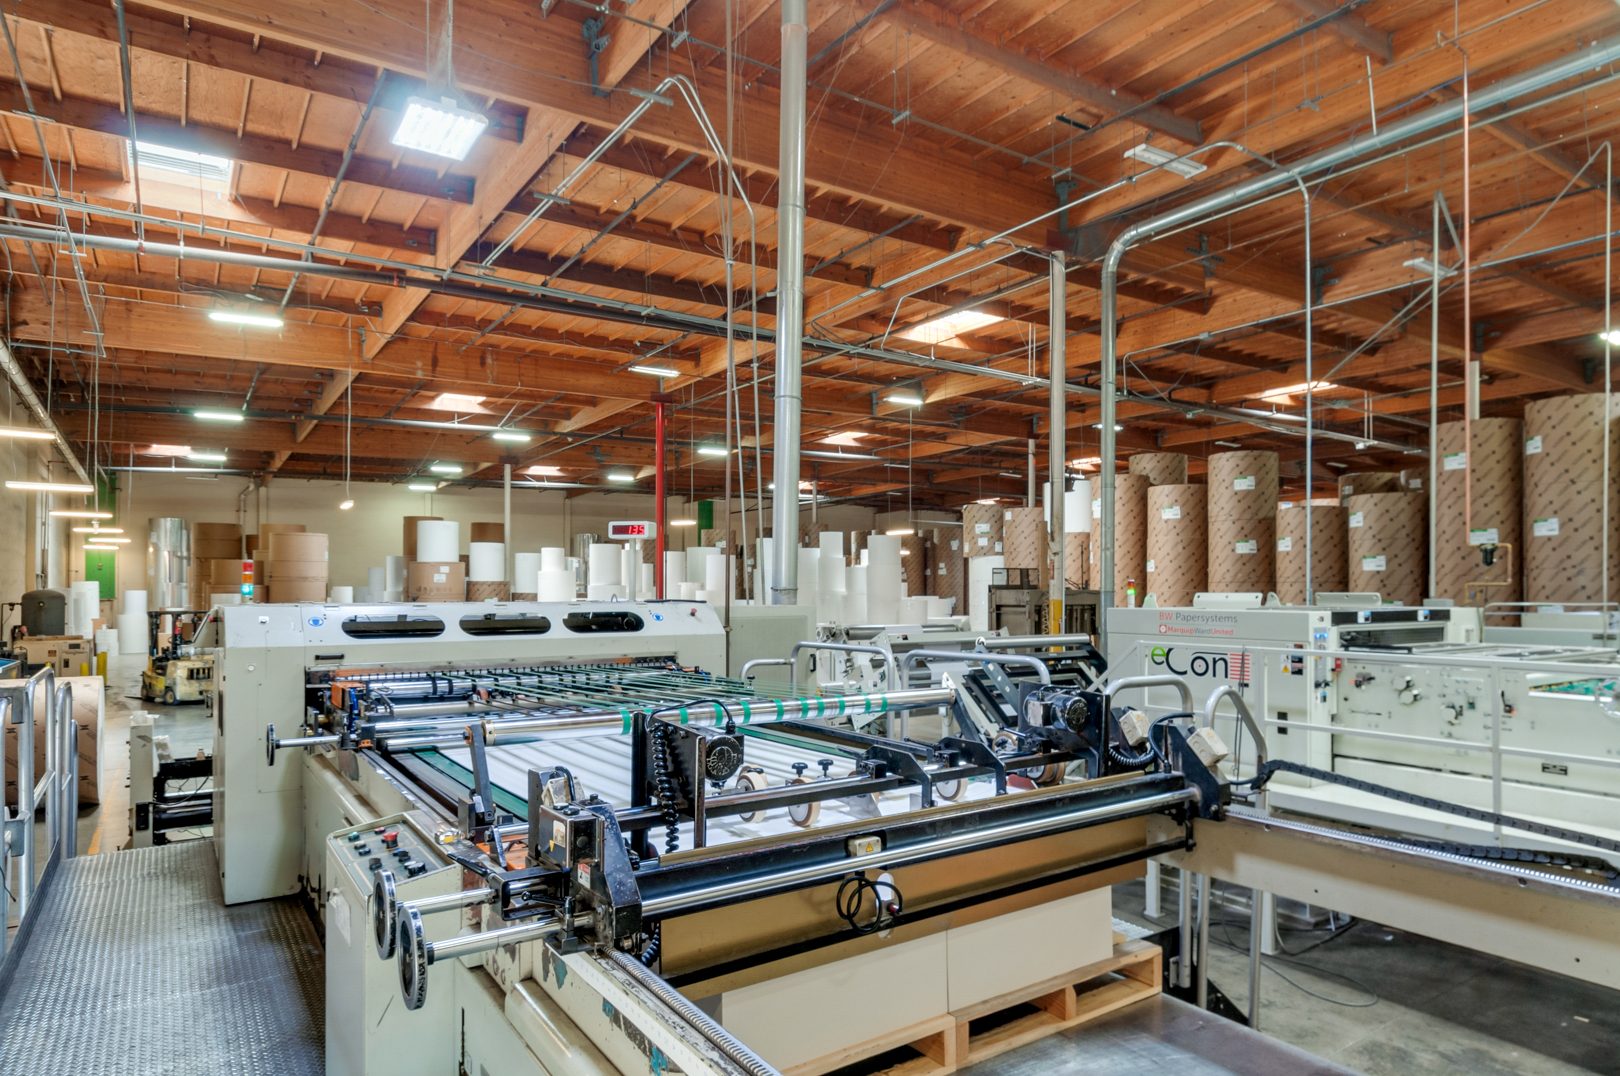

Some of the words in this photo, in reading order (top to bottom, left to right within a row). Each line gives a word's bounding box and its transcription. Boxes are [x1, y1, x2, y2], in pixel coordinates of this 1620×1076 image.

[628, 525, 644, 535] 135
[1159, 611, 1173, 620] BW
[1175, 612, 1238, 623] Papersystems
[1151, 646, 1228, 679] eCon
